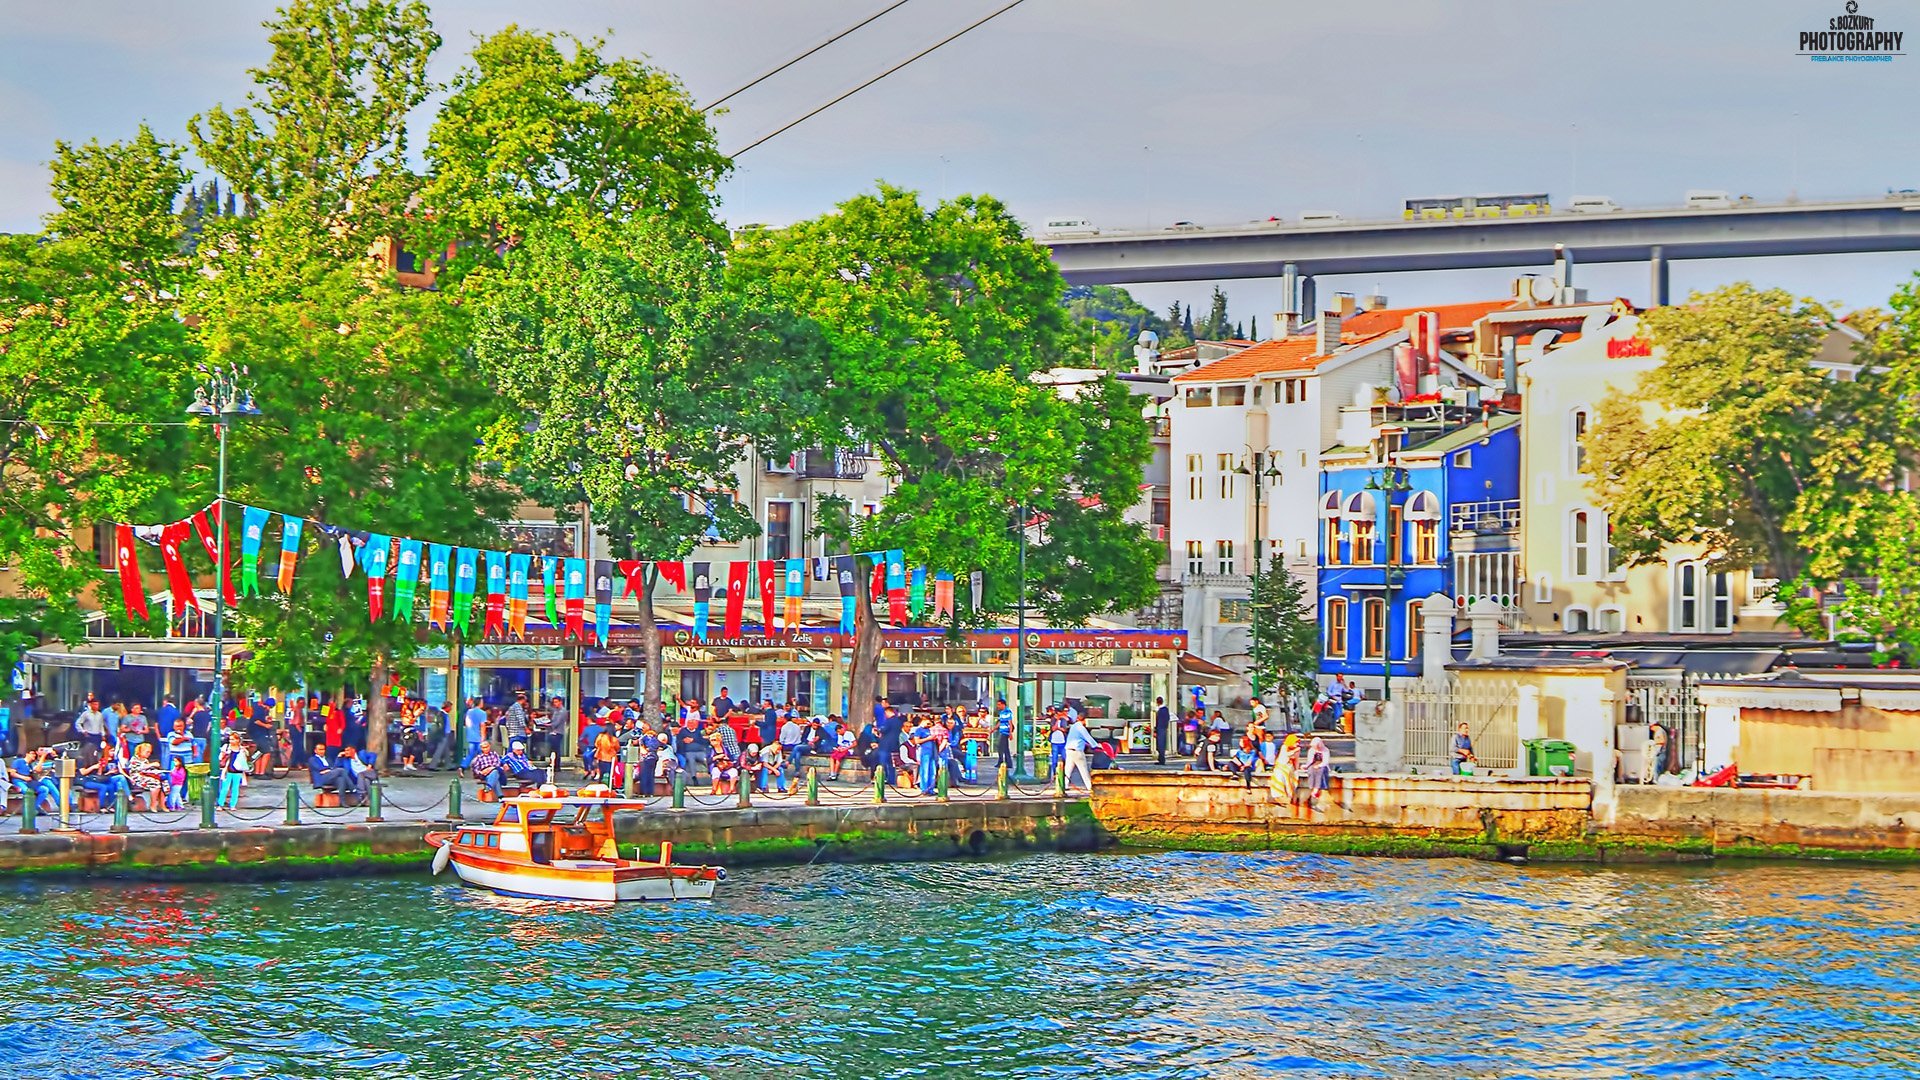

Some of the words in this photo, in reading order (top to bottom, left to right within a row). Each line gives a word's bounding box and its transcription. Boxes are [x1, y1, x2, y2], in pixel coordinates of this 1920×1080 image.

[531, 636, 561, 645] CAFE
[748, 638, 777, 646] CAFE
[885, 640, 940, 648] YELKEN
[1050, 640, 1121, 648] TOMURCUK
[1127, 640, 1160, 648] CAFE
